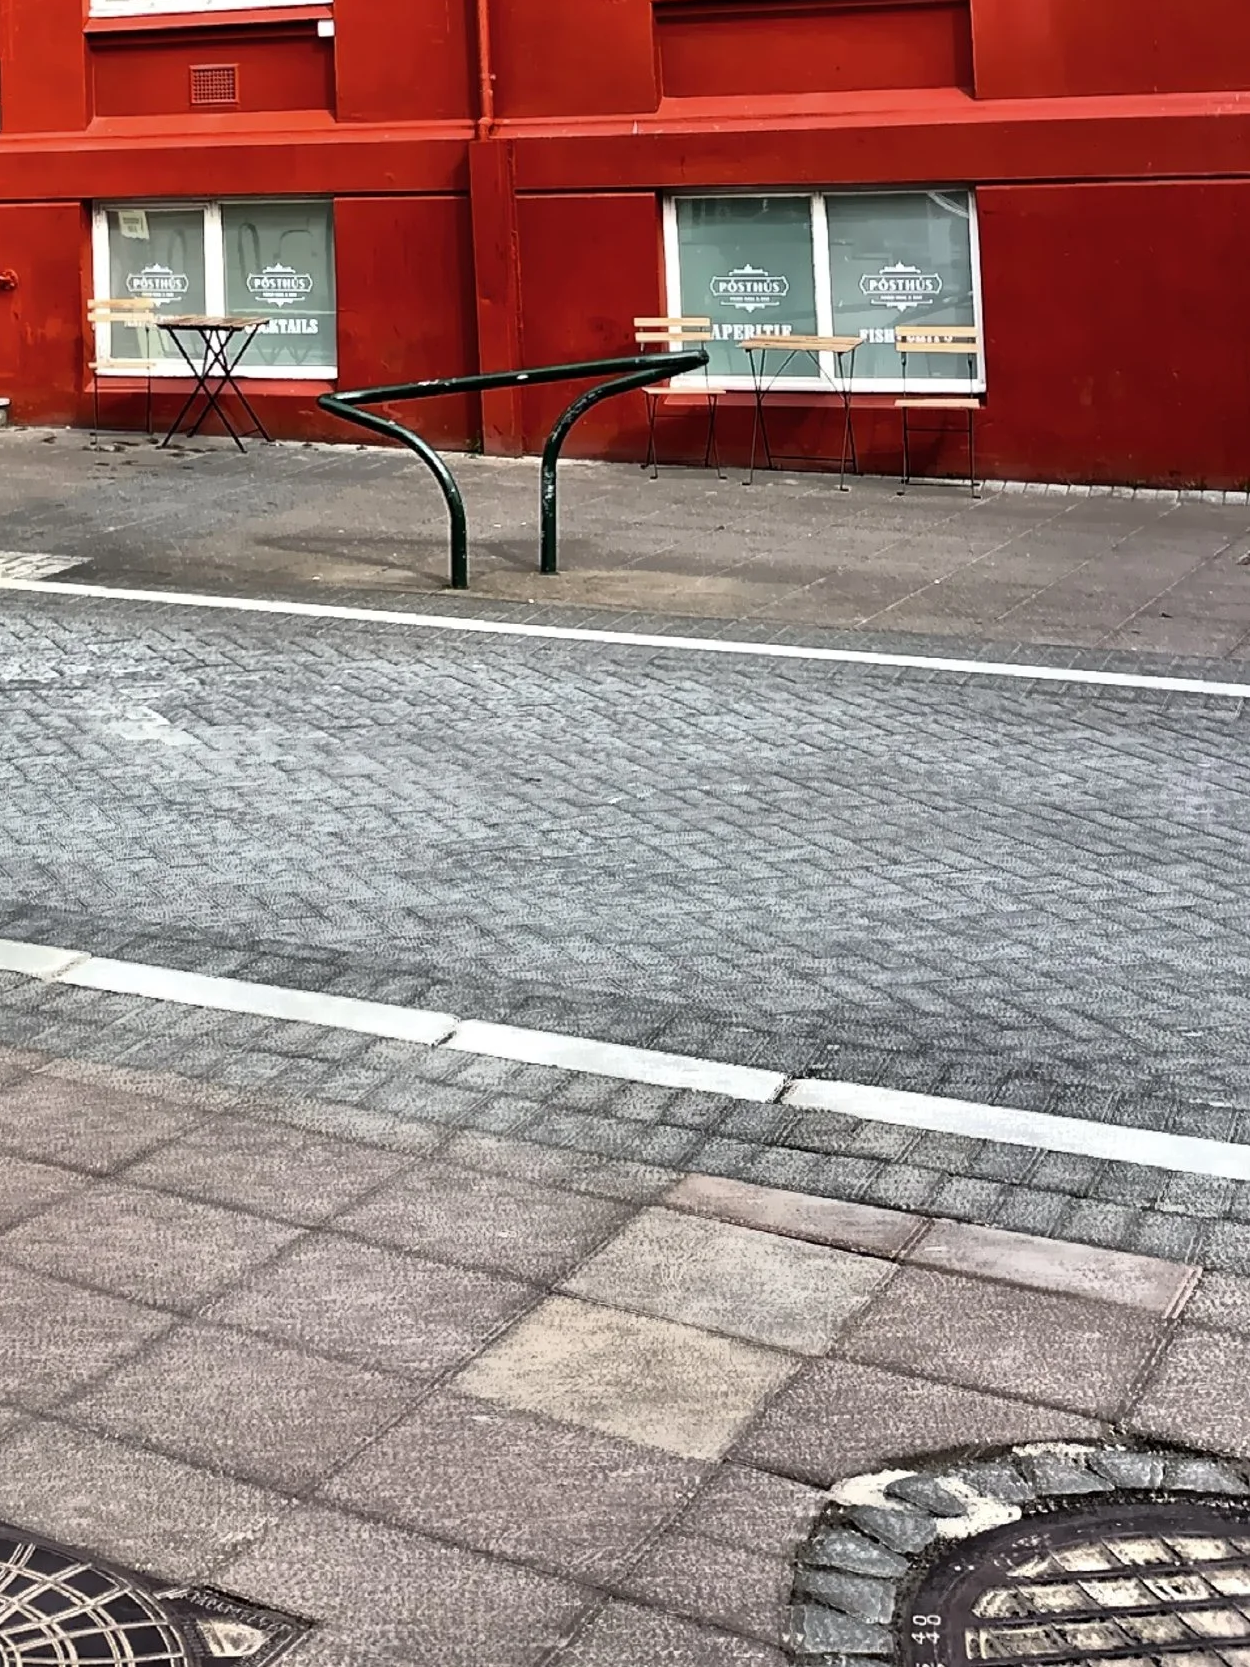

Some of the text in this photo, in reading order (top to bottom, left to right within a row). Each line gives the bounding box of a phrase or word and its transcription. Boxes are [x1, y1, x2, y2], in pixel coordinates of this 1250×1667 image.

[254, 276, 306, 289] PÓSTHÚS
[718, 279, 780, 293] PÓSTHÚS
[869, 277, 933, 291] PÓSTHÚS
[858, 329, 895, 343] FISH
